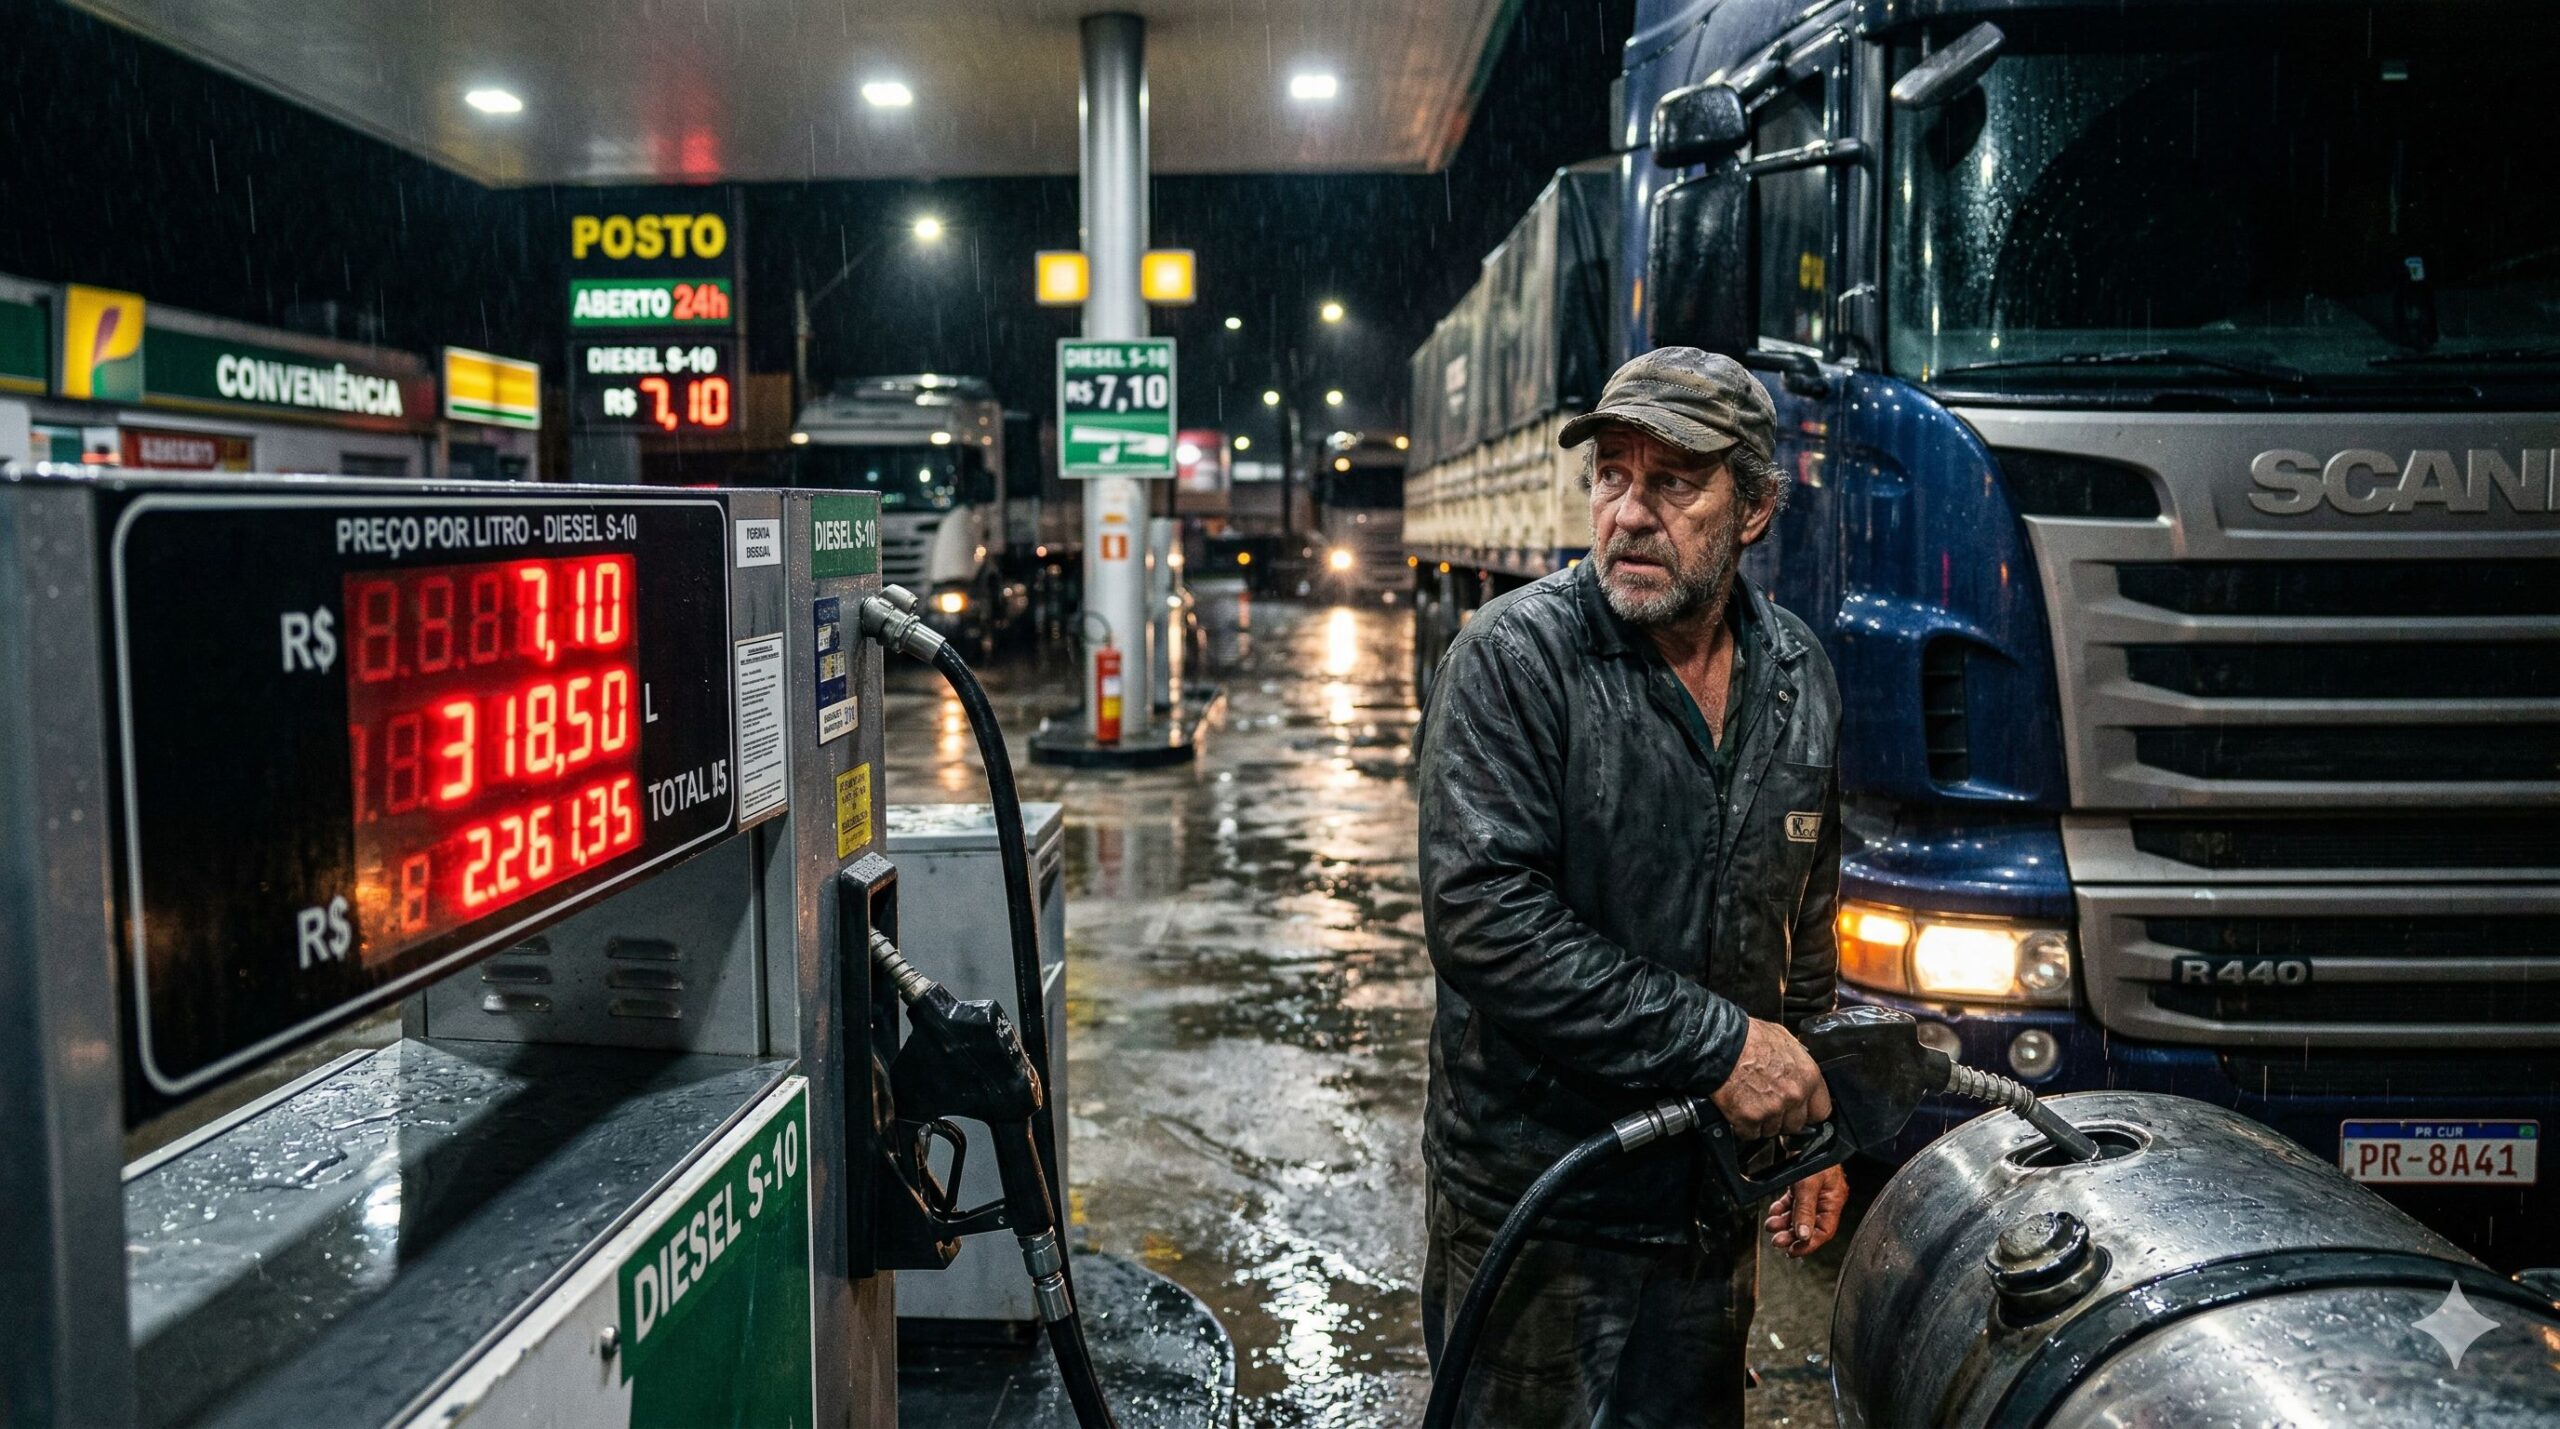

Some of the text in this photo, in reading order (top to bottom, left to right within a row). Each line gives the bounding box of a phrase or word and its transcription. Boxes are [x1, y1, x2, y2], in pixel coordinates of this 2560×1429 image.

[571, 213, 727, 259] POSTO
[573, 283, 730, 320] ABERTO 24h
[587, 346, 717, 374] DIESEL S-10
[1064, 347, 1126, 369] DIESEL
[216, 353, 404, 418] CONVENIÊNCIA
[603, 376, 729, 431] R$ 7,10
[1065, 373, 1168, 414] R$ 7,10
[336, 516, 420, 559] PREÇO
[424, 515, 470, 550] POR
[474, 514, 529, 548] LITRO
[543, 513, 603, 545] DIESEL
[605, 513, 637, 541] S-10
[814, 519, 876, 552] DIESEL S-10
[280, 561, 621, 674] R$ 7,10
[439, 669, 658, 801] 318,50 L
[648, 766, 710, 822] TOTAL
[297, 777, 632, 970] R$ 2.261,35
[2181, 959, 2308, 986] R 440
[2415, 1126, 2464, 1138] PR CUR
[2359, 1143, 2518, 1178] PR-8A41
[634, 1119, 798, 1345] DIESEL S-10
